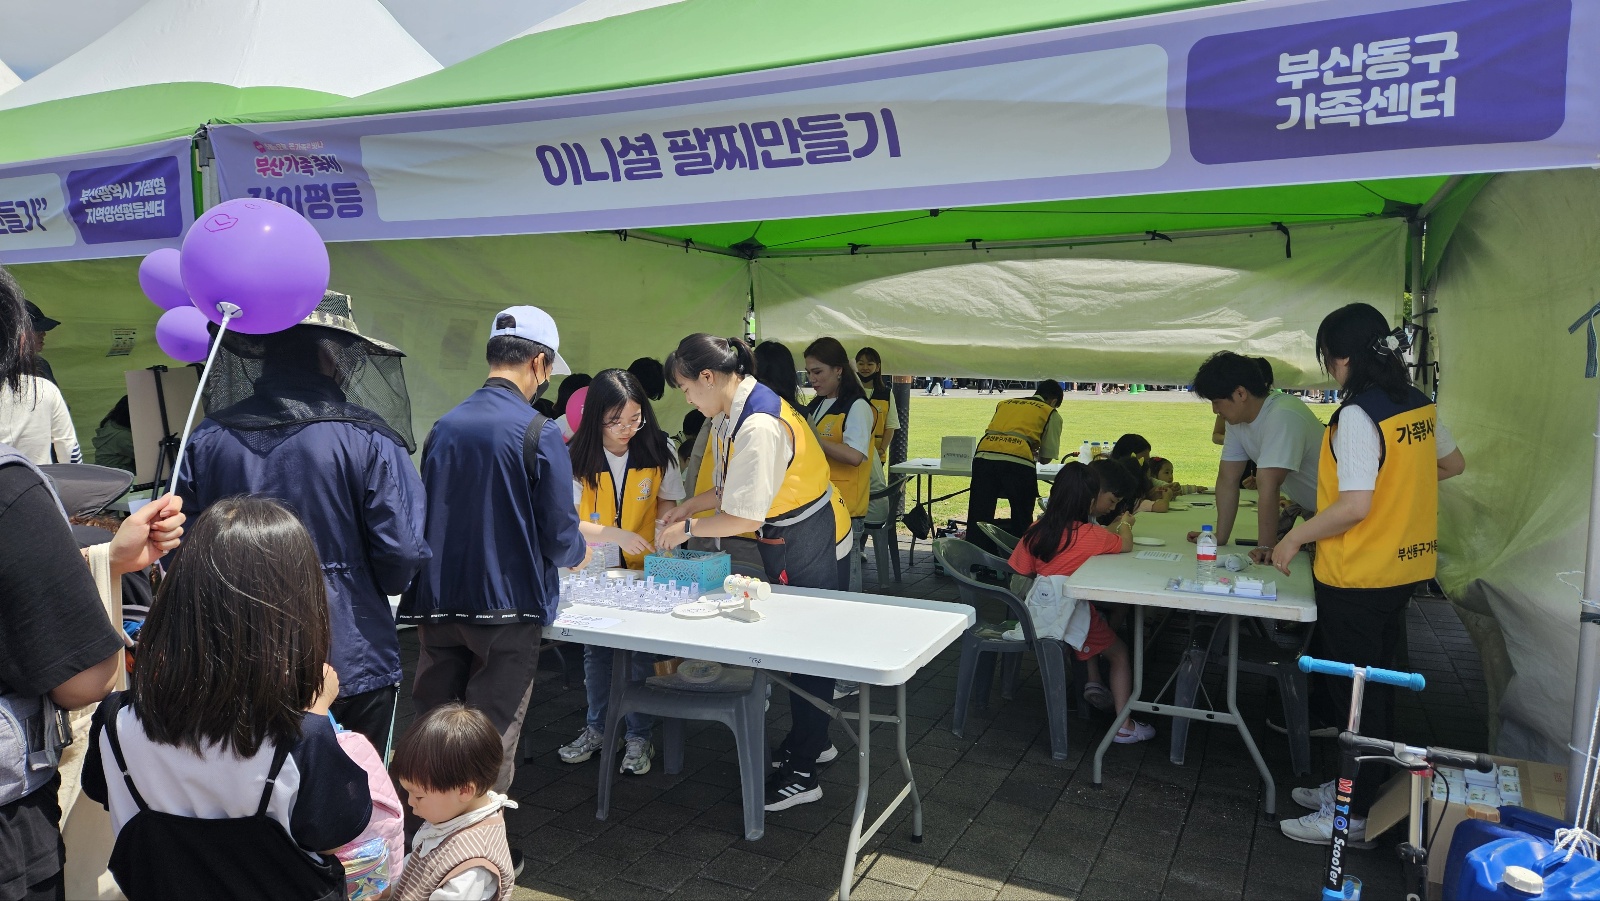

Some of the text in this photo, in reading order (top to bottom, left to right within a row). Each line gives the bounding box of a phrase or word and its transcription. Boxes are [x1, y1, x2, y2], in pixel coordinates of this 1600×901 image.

[1276, 31, 1459, 90] 부산동구
[1276, 76, 1456, 130] 가족센터
[535, 108, 902, 186] 이니셜 팔찌만들기
[80, 176, 167, 205] 부산광역시 거점형
[85, 199, 166, 225] 지역양성평등센터
